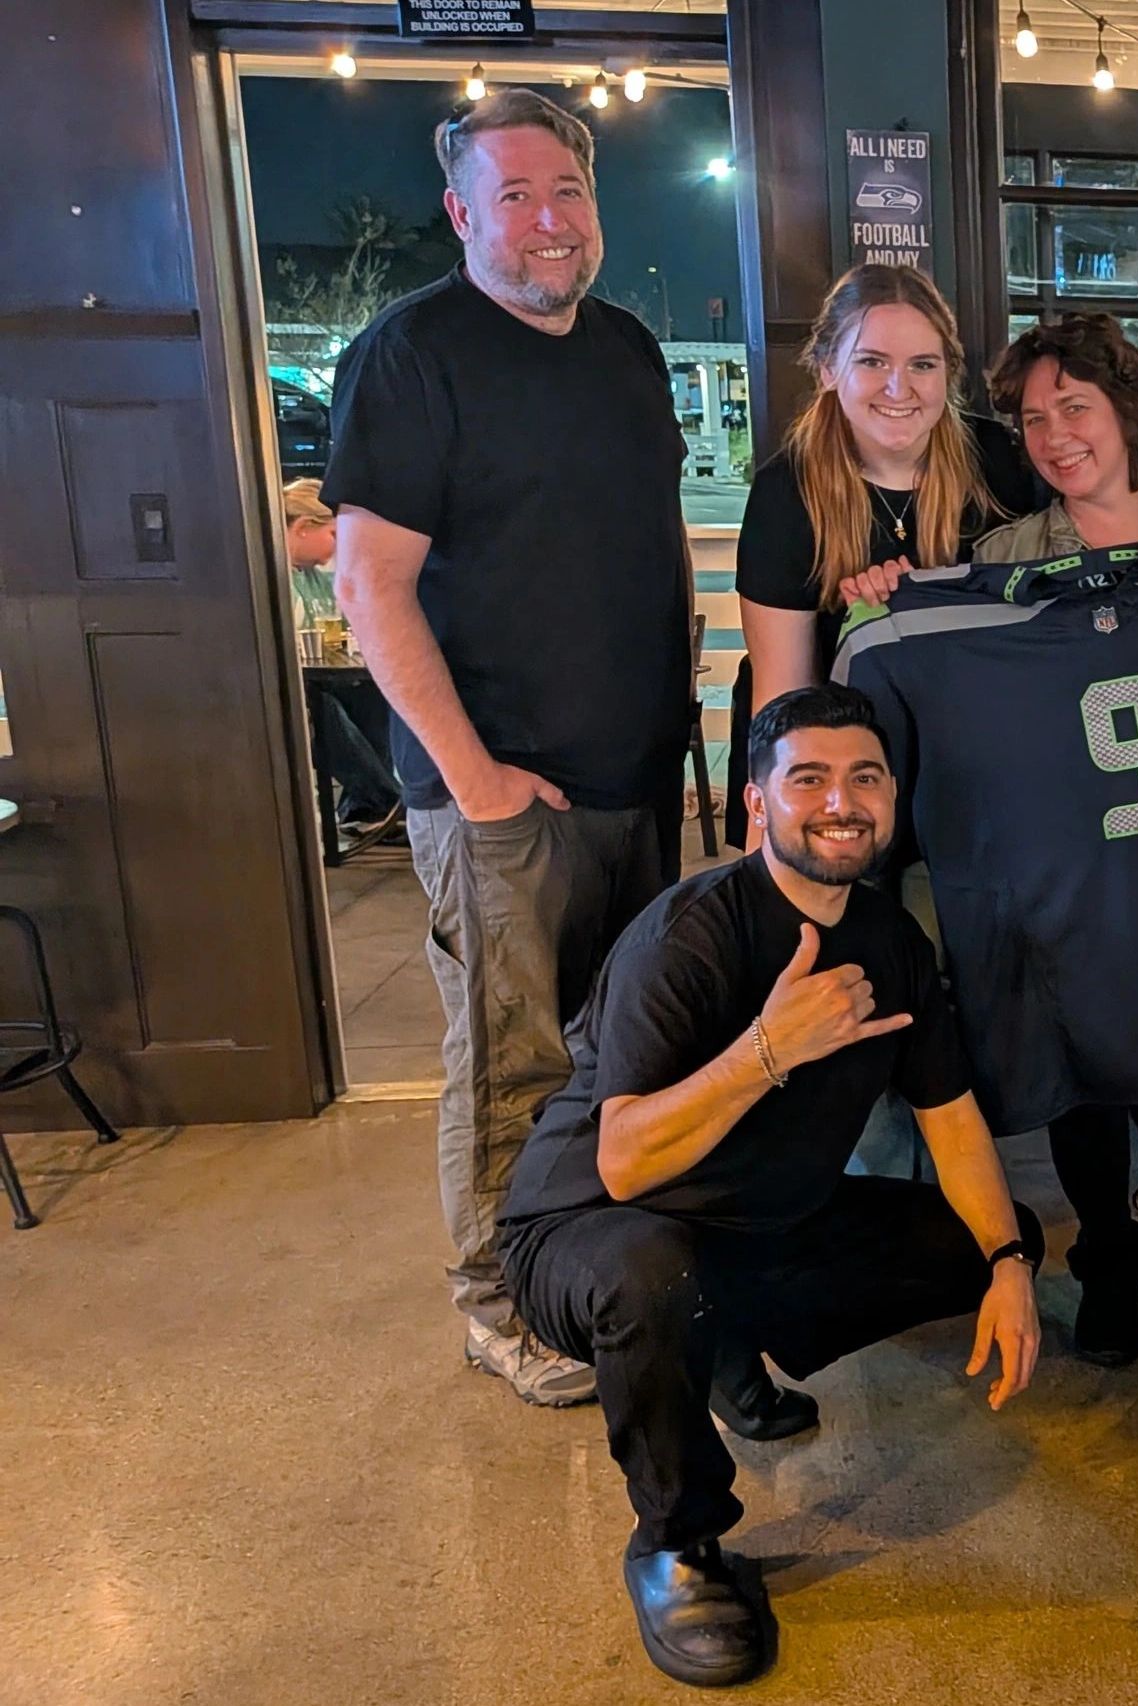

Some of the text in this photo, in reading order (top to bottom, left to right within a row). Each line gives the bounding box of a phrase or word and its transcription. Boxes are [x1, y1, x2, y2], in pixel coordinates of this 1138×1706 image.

[410, 0, 520, 10] THIS DOOR TO REMAIN
[421, 11, 510, 21] UNLOCKED WHEN
[410, 22, 524, 32] BUILDING IS OCCUPIED
[850, 137, 926, 158] ALL I NEED
[884, 159, 895, 173] IS
[853, 222, 930, 247] FOOTBALL
